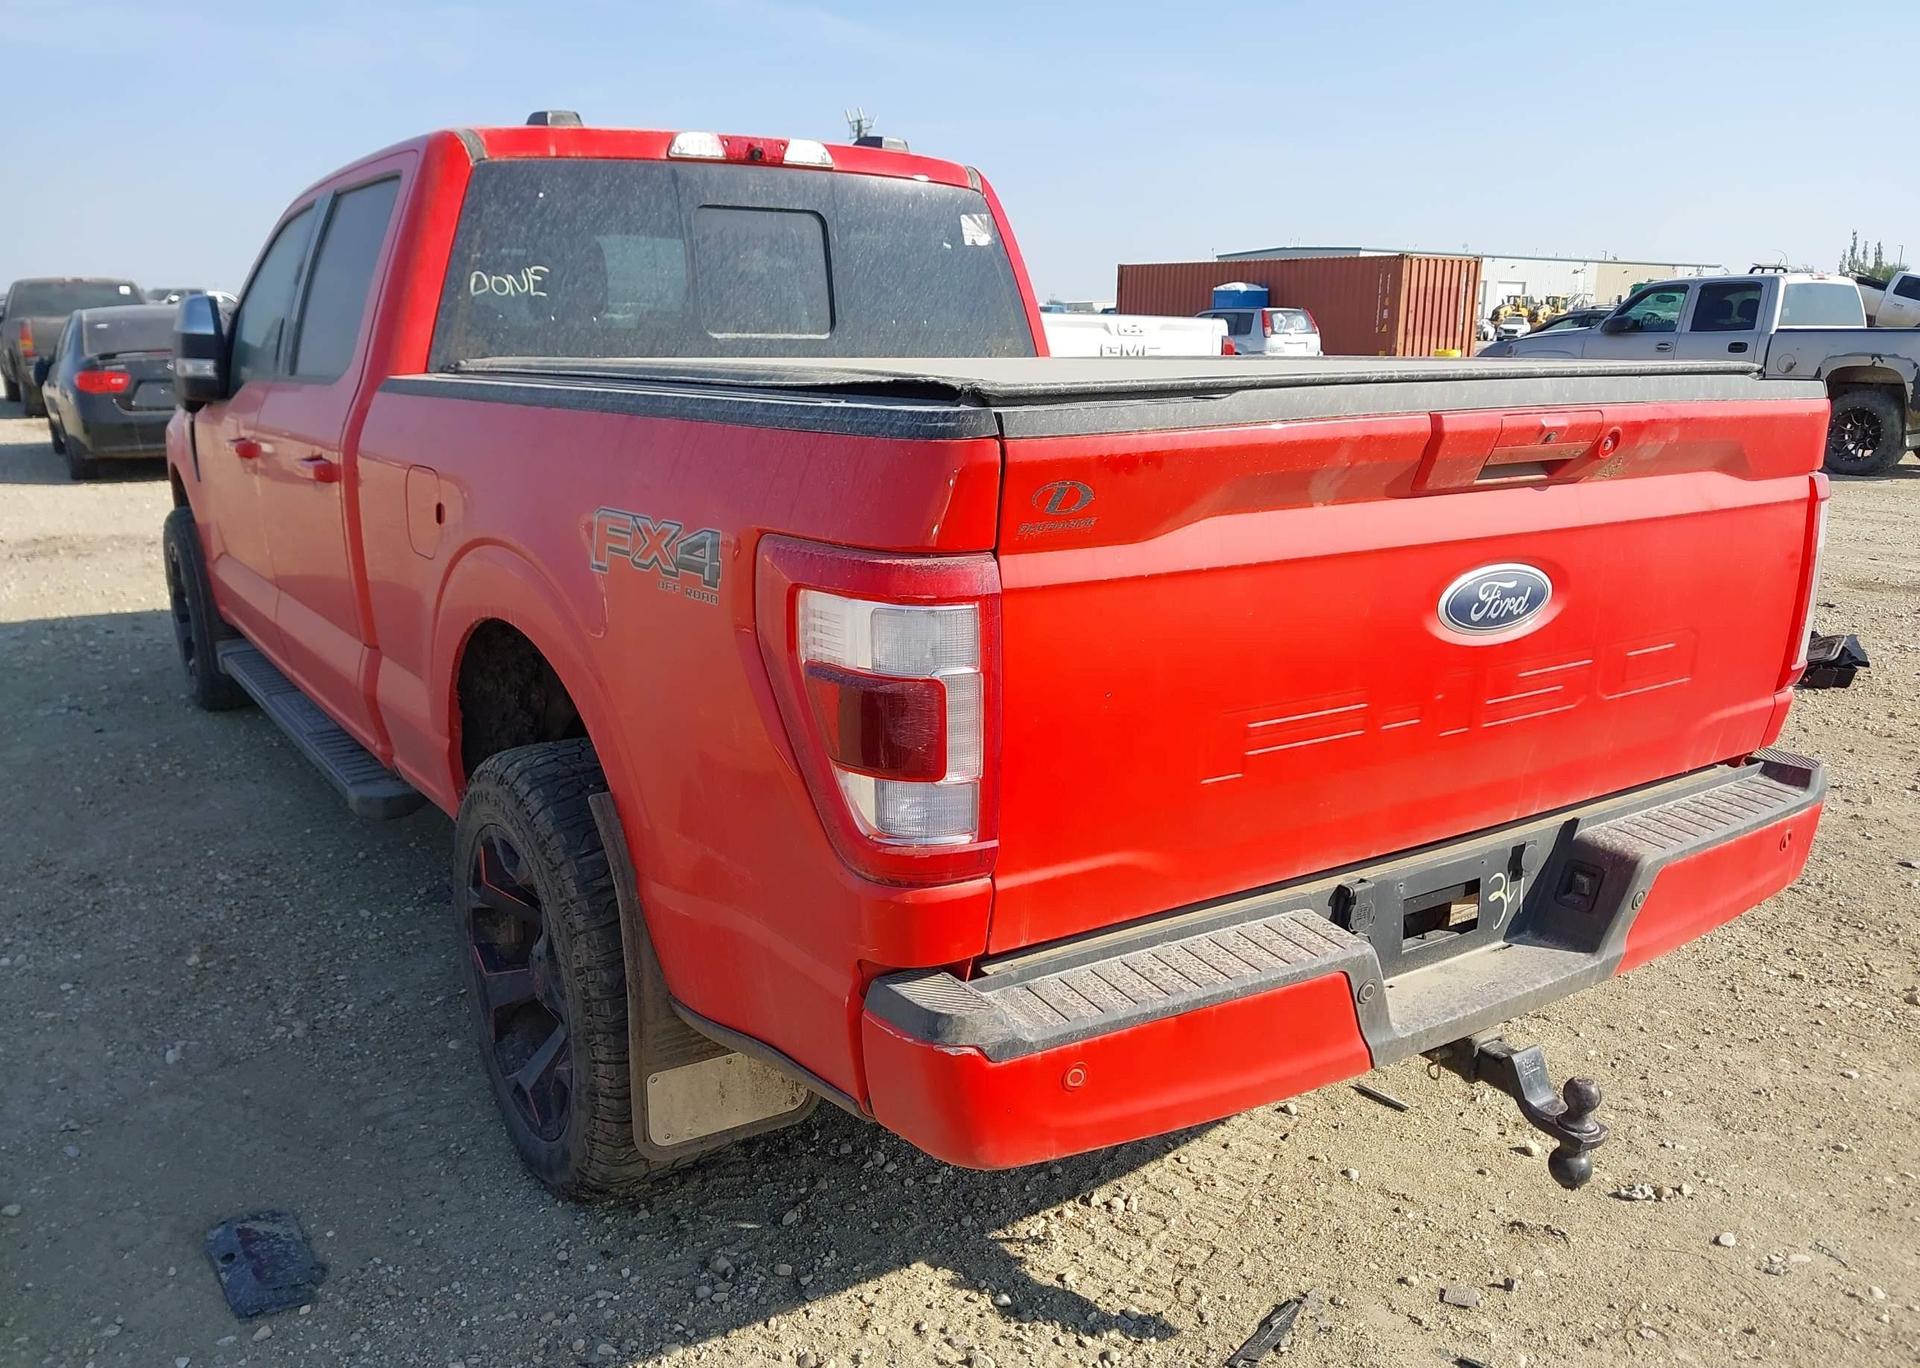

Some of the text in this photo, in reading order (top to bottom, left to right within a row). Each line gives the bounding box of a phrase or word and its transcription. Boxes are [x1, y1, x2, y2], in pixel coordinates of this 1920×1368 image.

[470, 266, 549, 296] DONE
[590, 506, 721, 589] FX4
[1470, 580, 1531, 622] Ford
